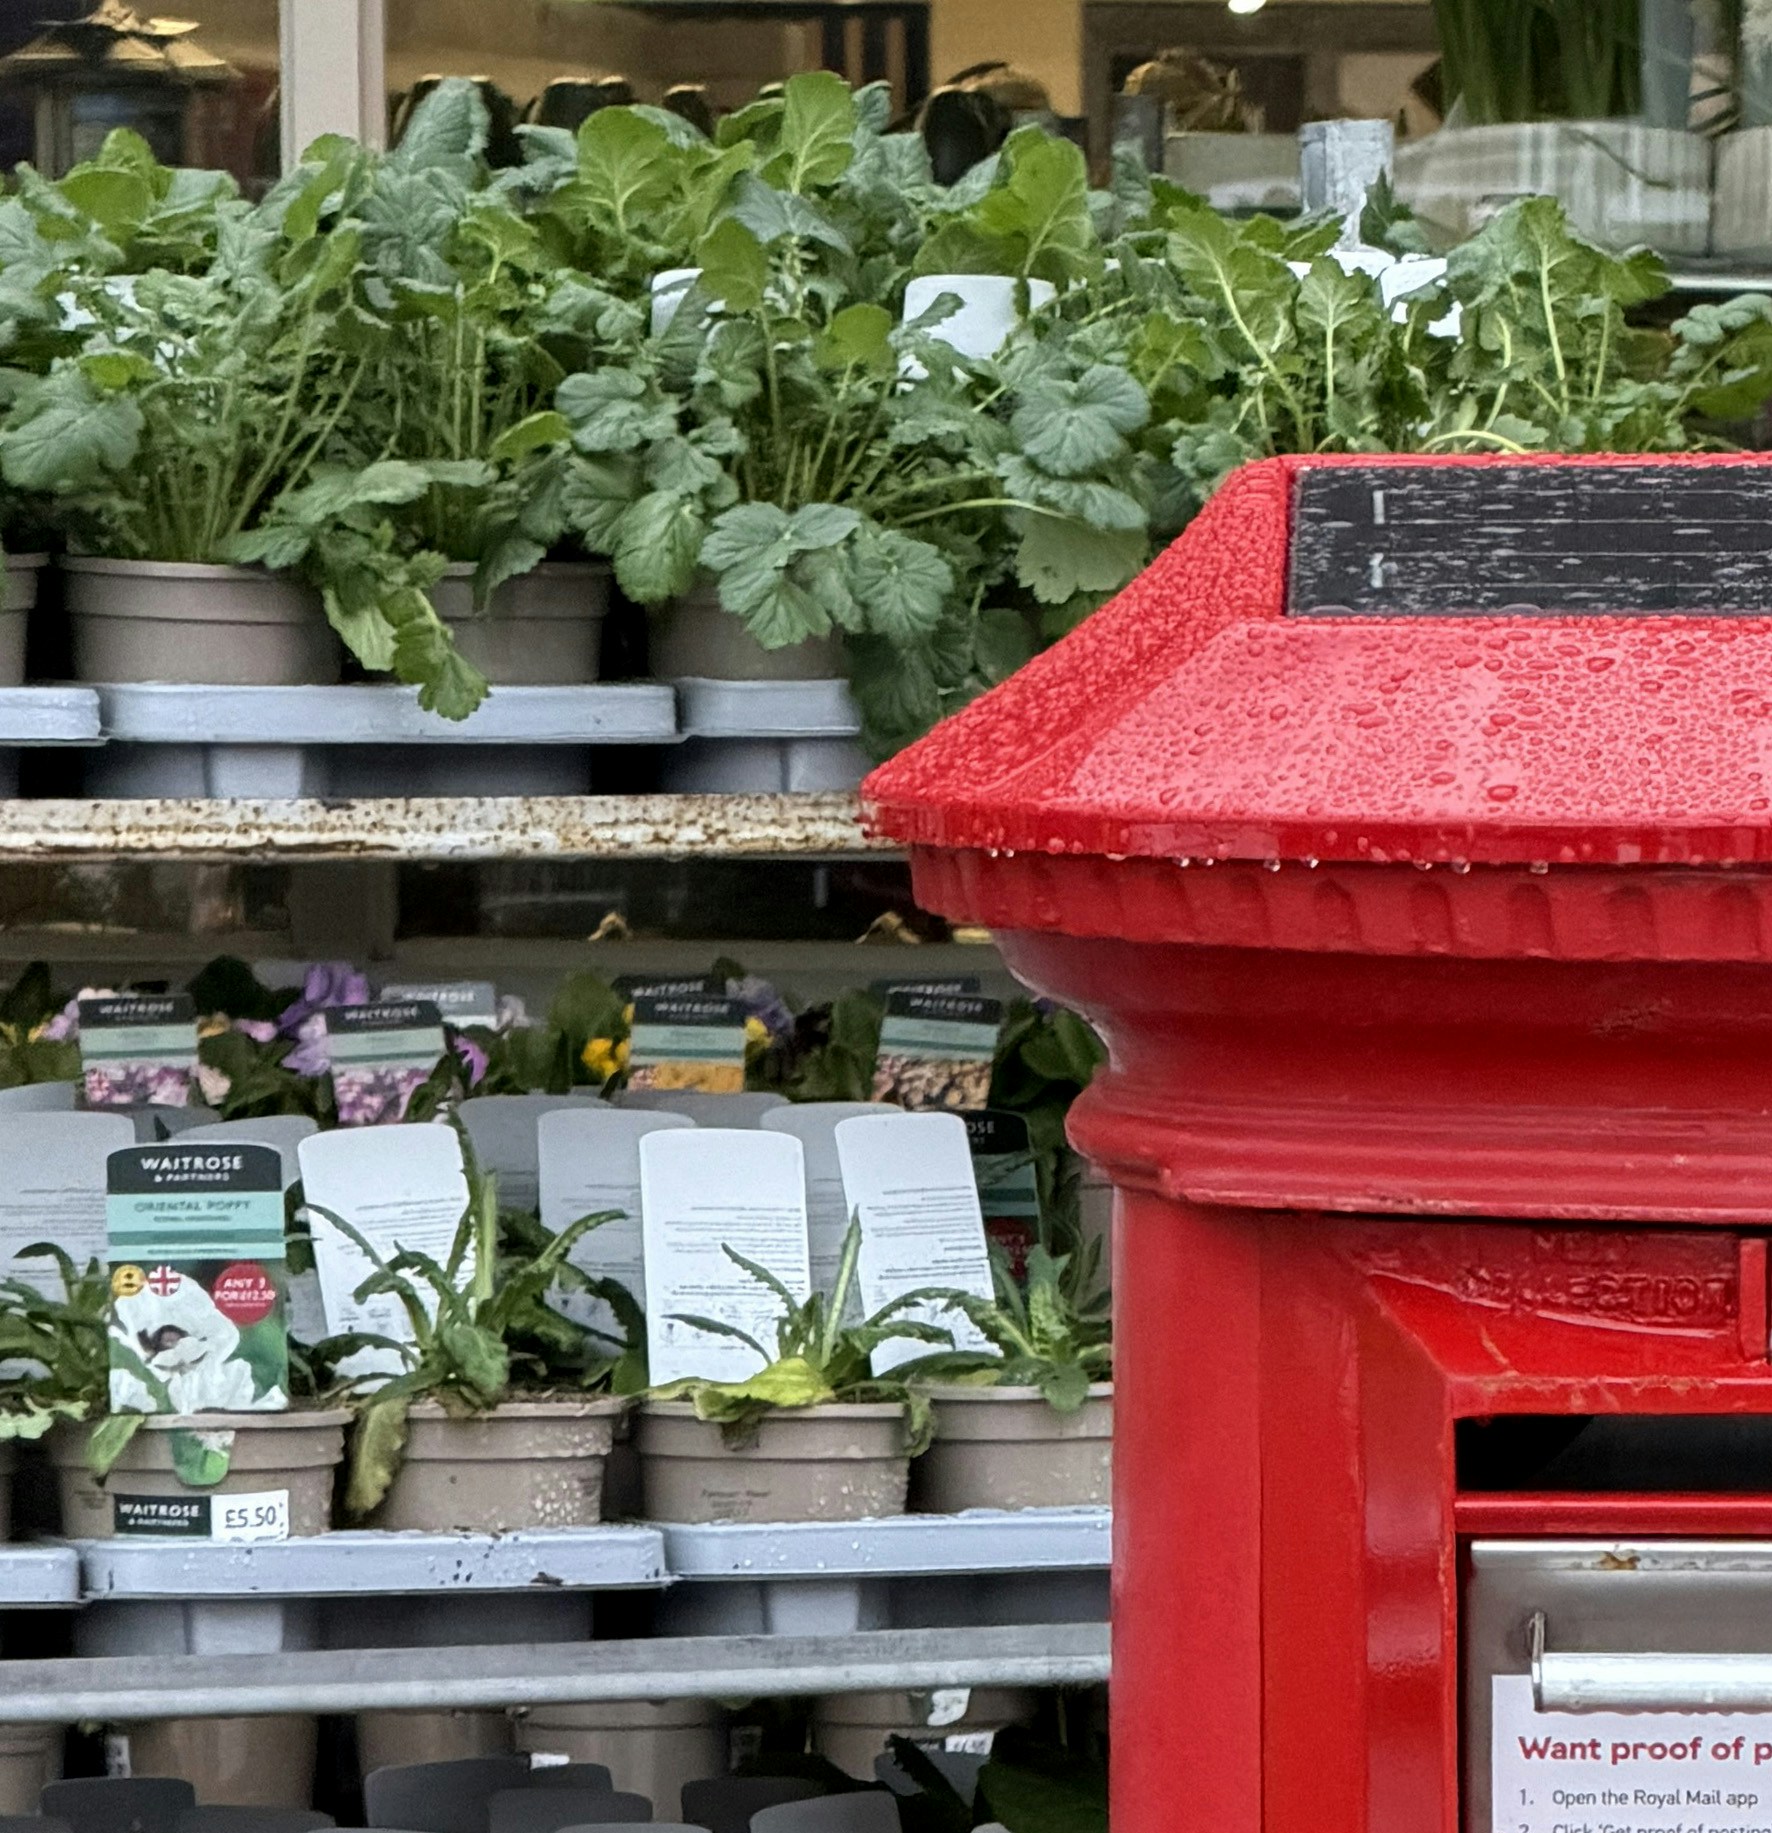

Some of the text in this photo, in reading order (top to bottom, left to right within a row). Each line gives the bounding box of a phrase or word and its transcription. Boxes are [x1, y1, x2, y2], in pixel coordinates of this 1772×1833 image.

[140, 1155, 244, 1171] WAITROSE
[118, 1503, 201, 1518] WAITROSE
[1518, 1735, 1602, 1761] Want
[1611, 1735, 1703, 1766] proof
[1711, 1735, 1747, 1761] of
[1518, 1789, 1759, 1810] 1. Open the Royal Mail app
